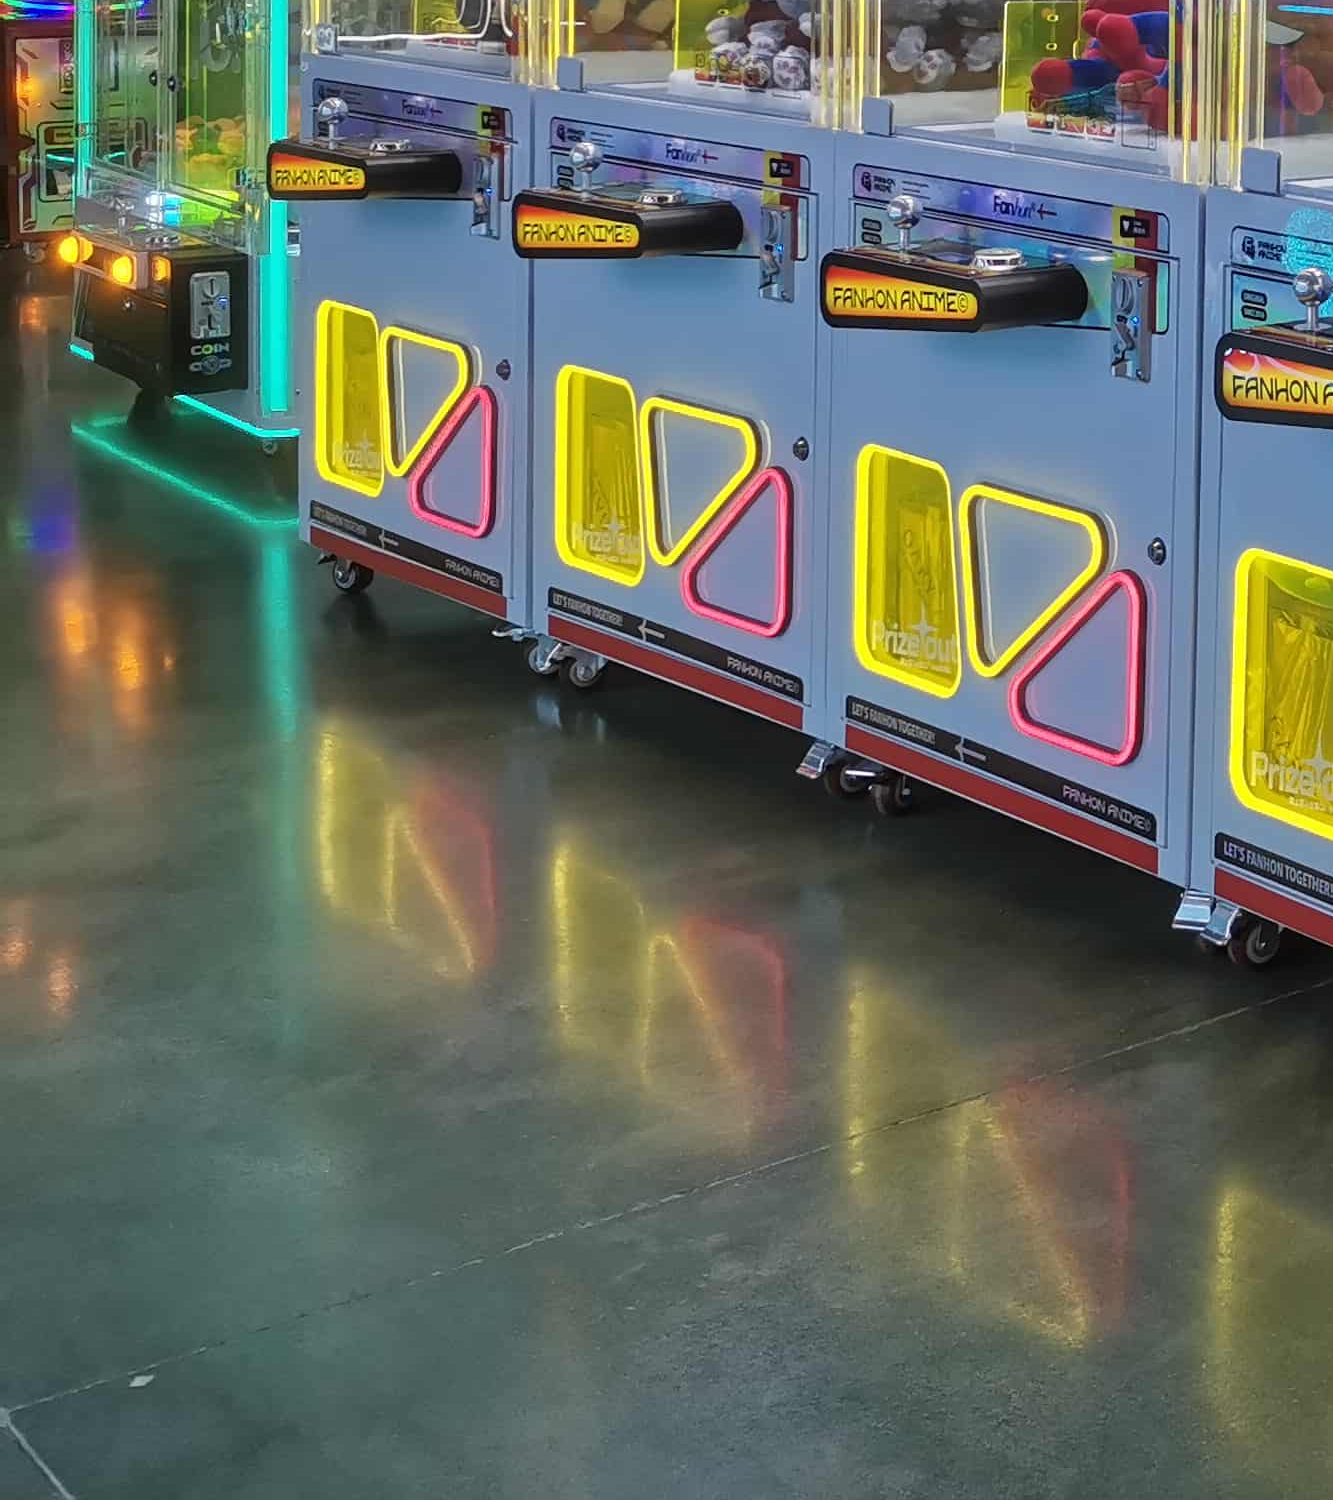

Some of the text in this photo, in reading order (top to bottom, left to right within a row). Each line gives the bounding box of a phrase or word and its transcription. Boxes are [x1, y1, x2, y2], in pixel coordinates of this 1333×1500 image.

[275, 169, 316, 186] FANHON
[523, 223, 575, 243] FANHON
[832, 286, 899, 311] FANHON
[1232, 374, 1318, 406] FANHON
[1222, 840, 1246, 863] LET'S
[1246, 850, 1283, 878] FANHON
